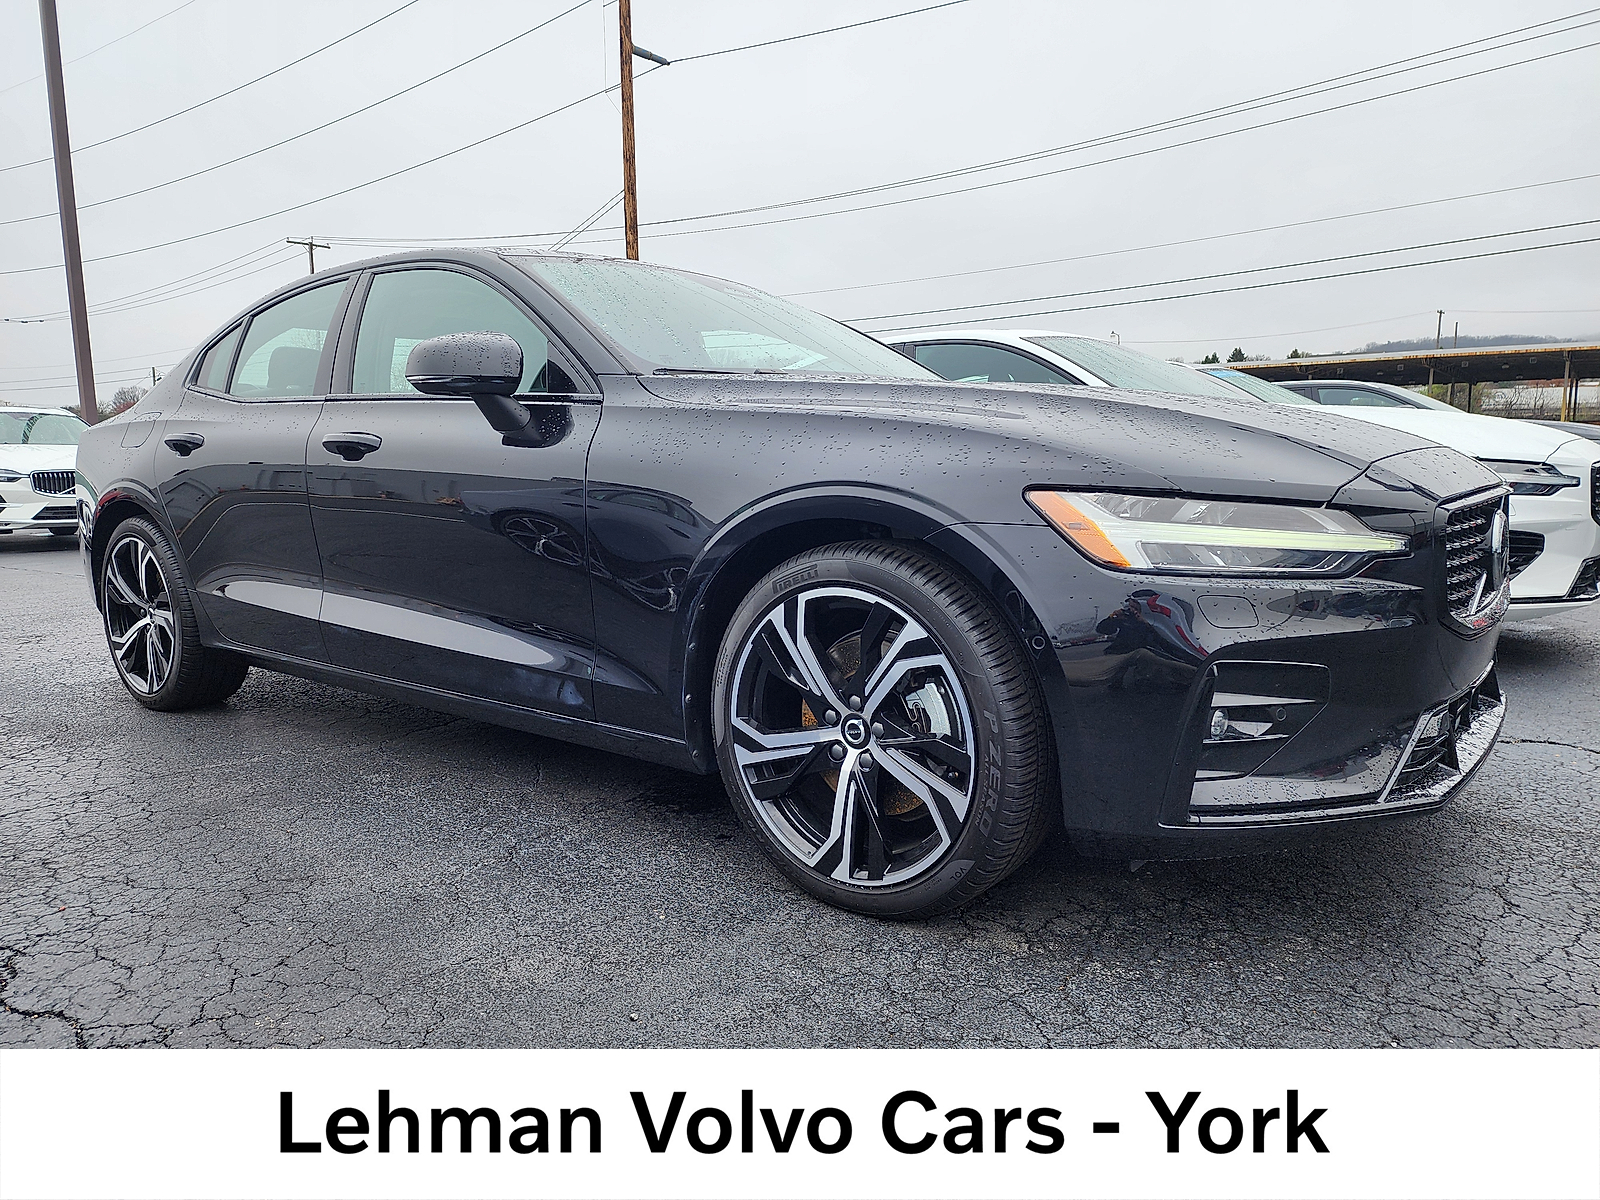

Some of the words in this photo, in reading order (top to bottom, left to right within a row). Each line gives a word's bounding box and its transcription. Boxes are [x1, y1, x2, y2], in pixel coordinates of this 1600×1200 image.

[771, 563, 819, 594] PIRELLI
[983, 709, 999, 734] P
[980, 739, 1002, 837] ZERO
[949, 867, 967, 881] VOL
